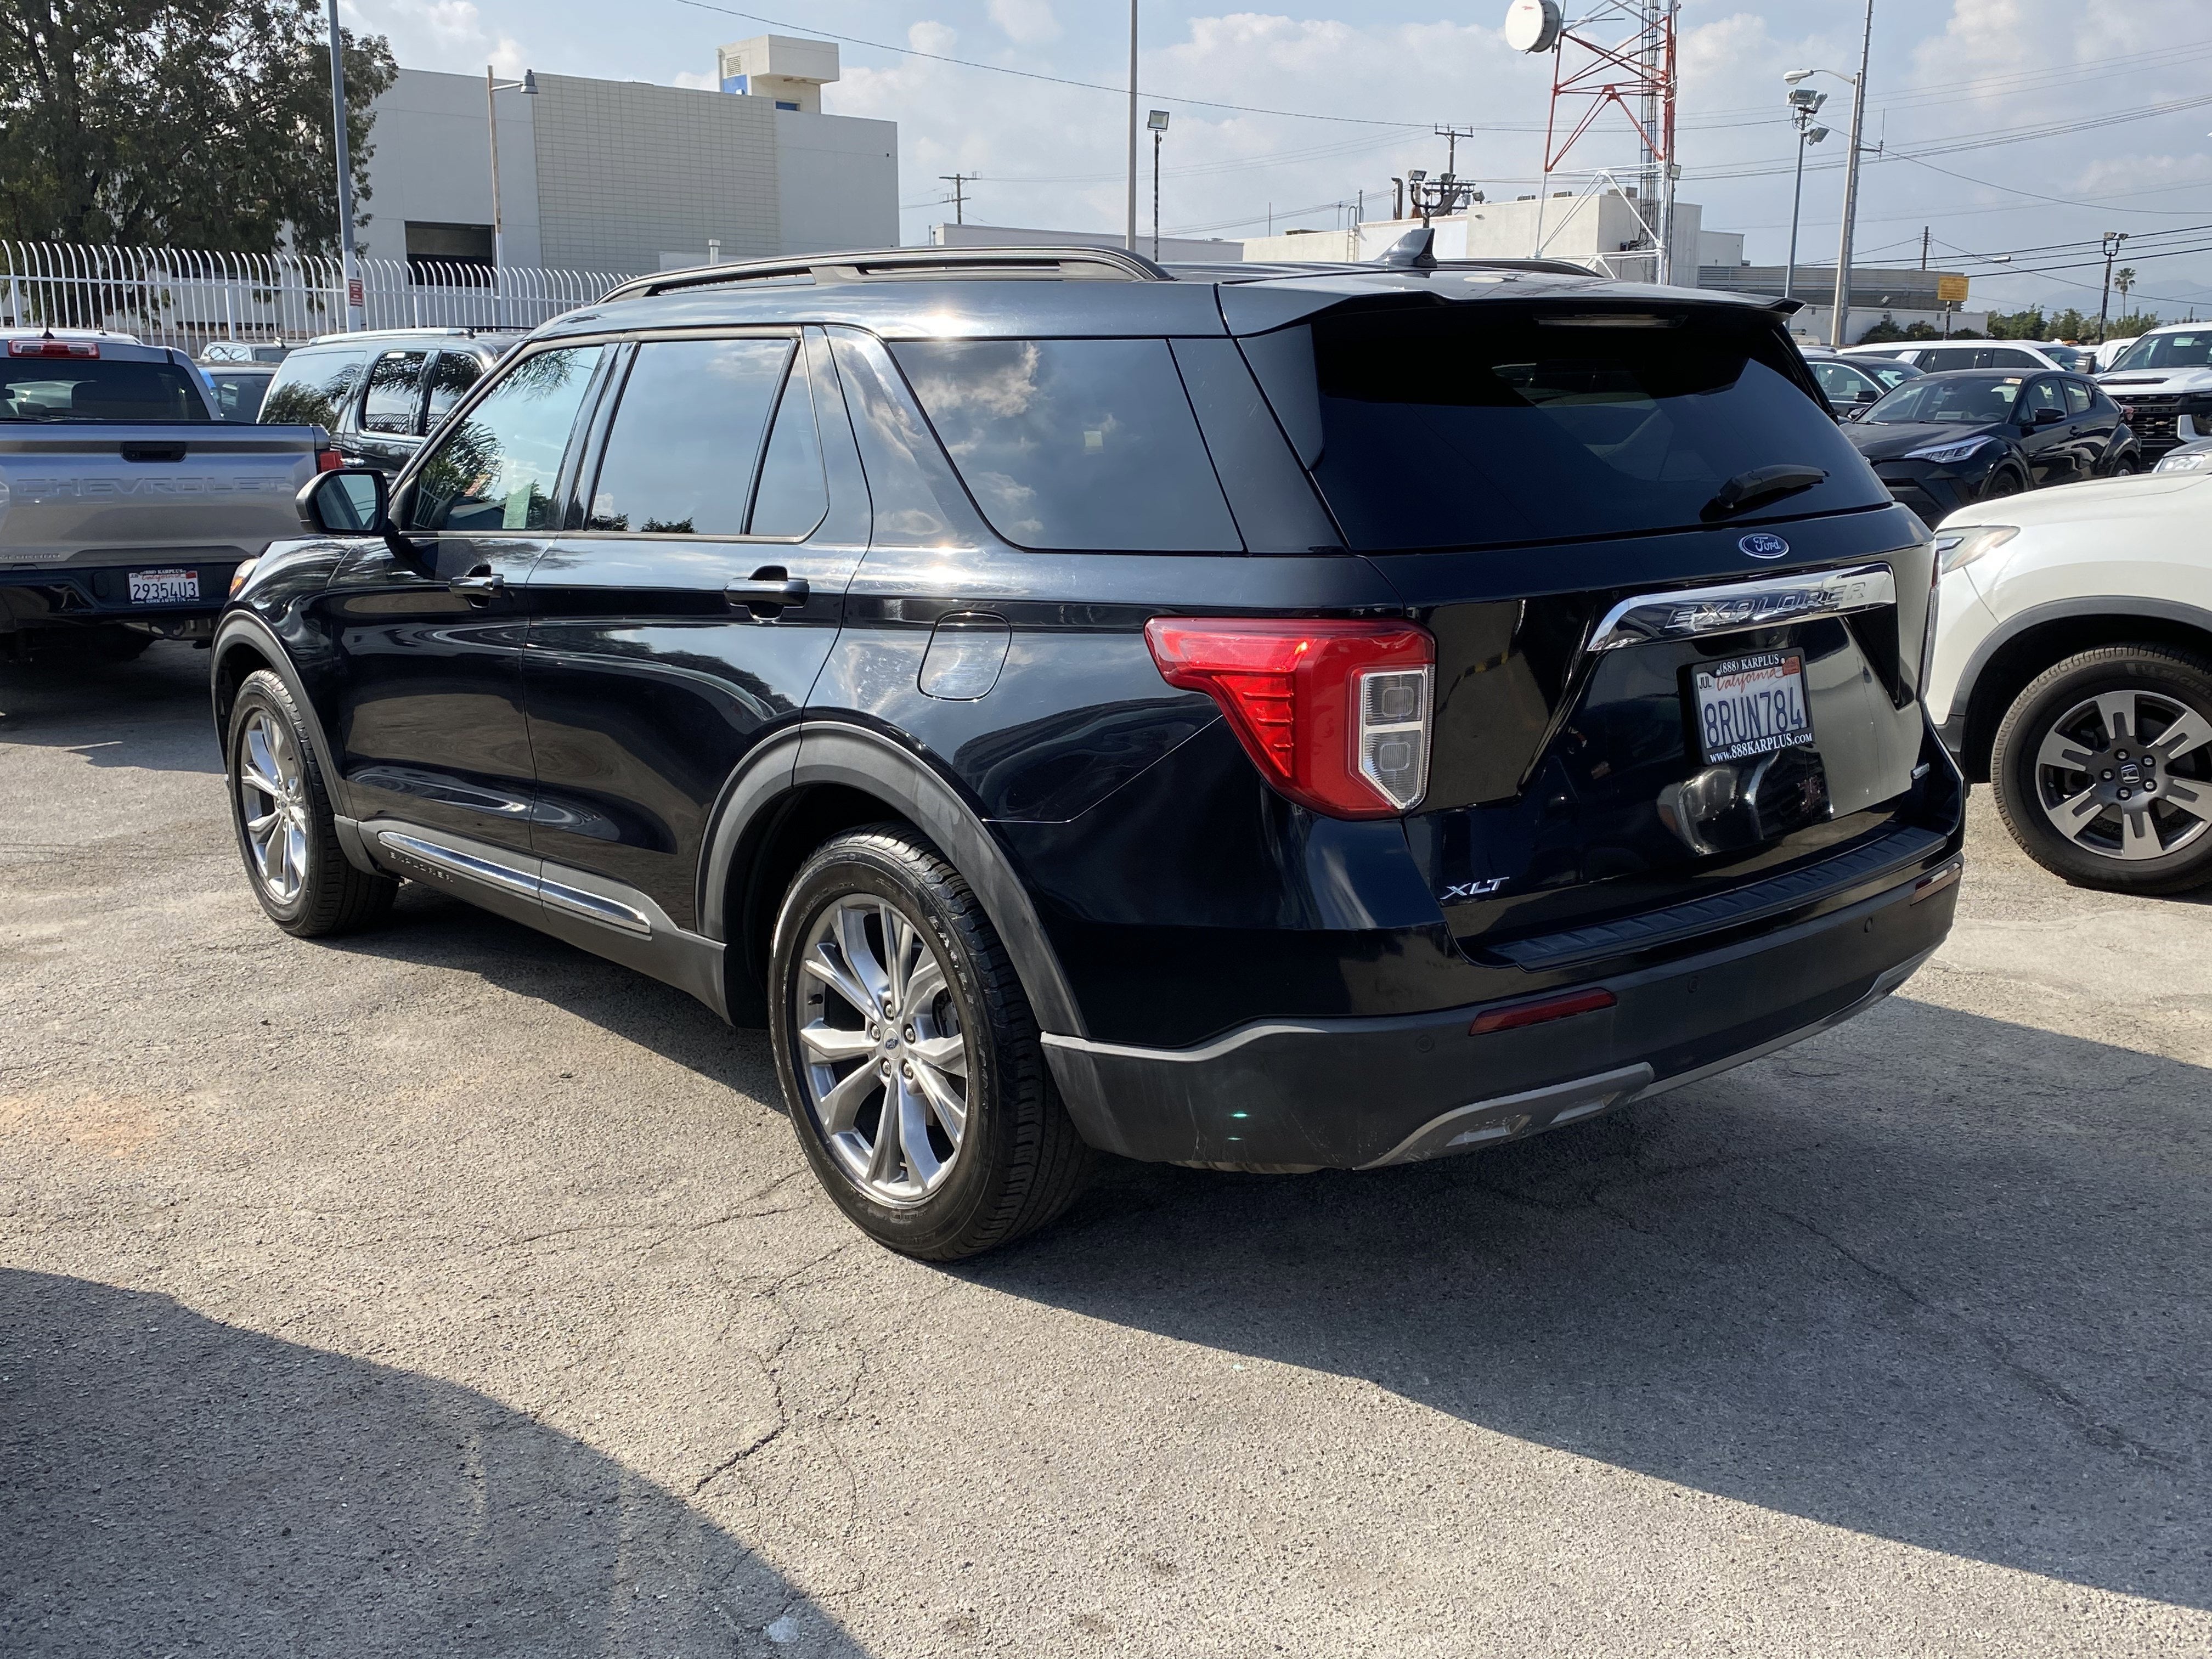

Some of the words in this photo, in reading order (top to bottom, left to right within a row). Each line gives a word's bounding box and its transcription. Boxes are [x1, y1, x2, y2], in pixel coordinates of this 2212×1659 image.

[17, 477, 287, 495] CHEVROLET
[1753, 537, 1781, 552] Ford
[133, 582, 196, 602] 29354U3
[1665, 581, 1866, 629] EXPLORER
[1719, 660, 1739, 674] (888)
[1741, 654, 1779, 670] KARPLUS
[1699, 675, 1712, 689] JUL
[1716, 668, 1785, 693] California
[1704, 686, 1803, 747] 8RUN784
[1440, 876, 1510, 900] XLT
